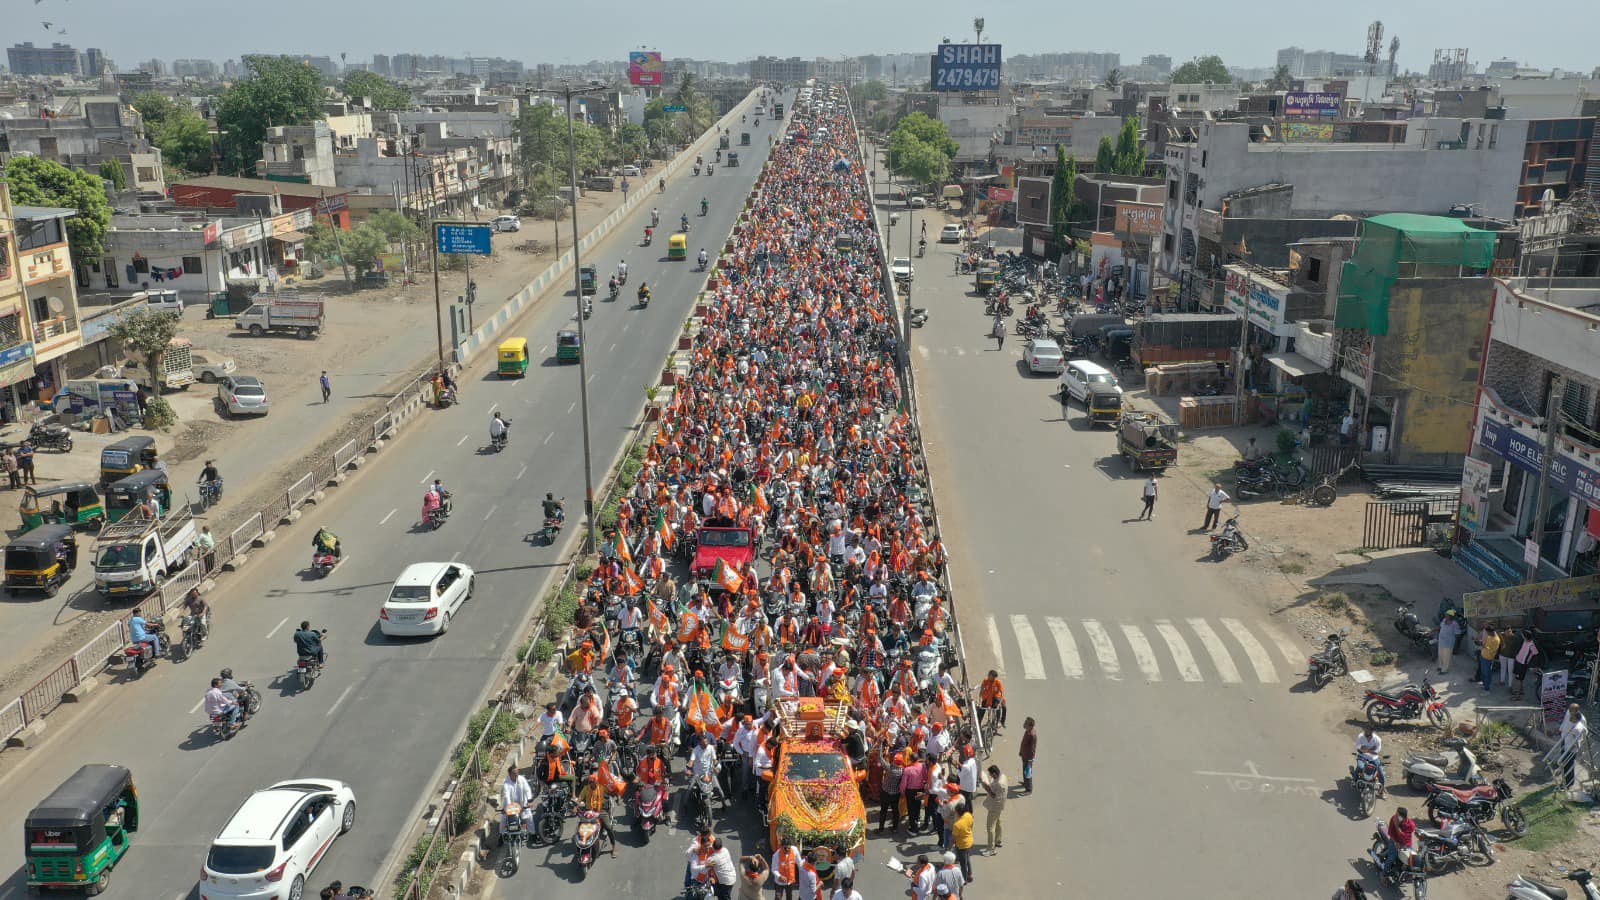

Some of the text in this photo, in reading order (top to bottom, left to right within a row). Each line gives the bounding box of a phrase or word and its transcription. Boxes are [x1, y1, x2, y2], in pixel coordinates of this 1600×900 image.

[943, 46, 996, 64] SHAH
[937, 68, 999, 86] 2479479
[1509, 438, 1526, 454] HOP
[1527, 447, 1568, 477] ELERIC
